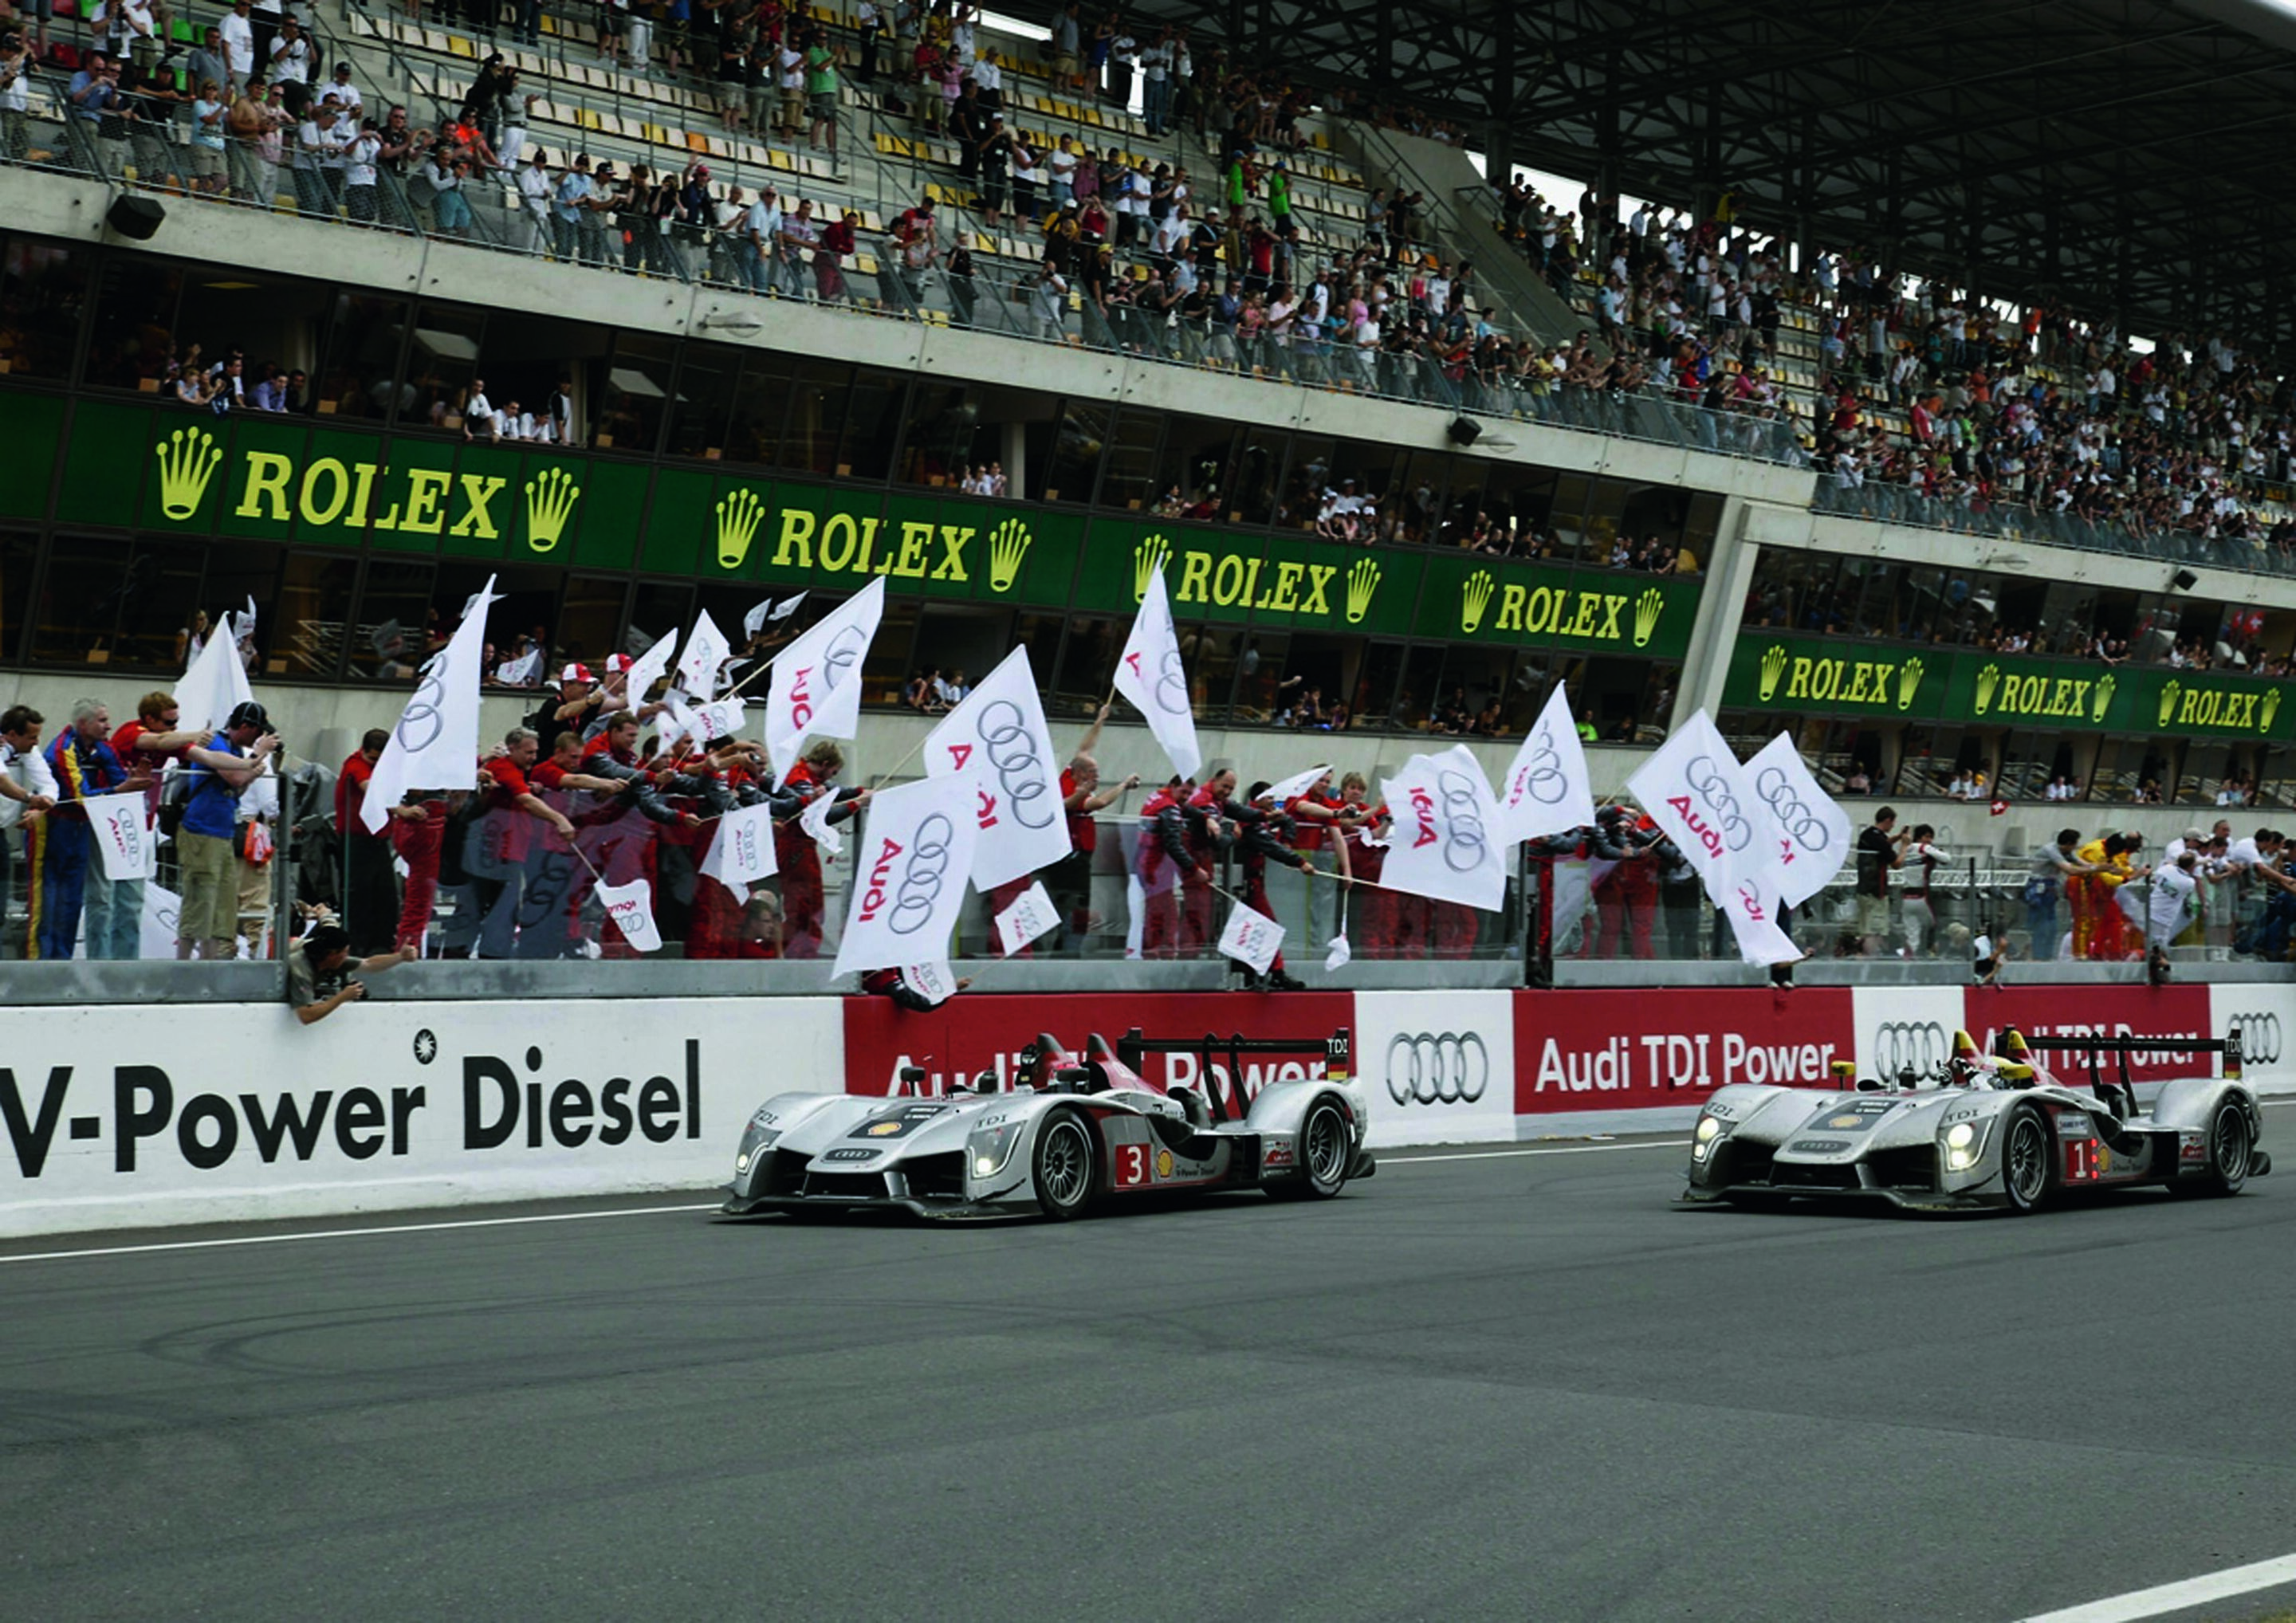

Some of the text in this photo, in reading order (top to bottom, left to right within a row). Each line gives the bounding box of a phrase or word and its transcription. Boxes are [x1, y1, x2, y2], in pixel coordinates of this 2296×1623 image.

[235, 451, 506, 539] ROLEX
[771, 509, 976, 581] ROLEX
[1176, 551, 1337, 614] ROLEX
[1496, 584, 1628, 639] ROLEX
[1787, 658, 1894, 703] ROLEX
[1998, 675, 2090, 717] ROLEX
[2178, 690, 2259, 727] ROLEX
[1666, 796, 1724, 859] Audi
[859, 838, 903, 922] Audi
[1327, 1038, 1348, 1054] TDI
[1535, 1032, 1835, 1092] Audi TDI Power
[0, 1039, 700, 1178] V-Power Diesel
[977, 1114, 1008, 1127] TDI
[1706, 1101, 1734, 1117] TDI
[1948, 1110, 1979, 1122] TDI
[1126, 1146, 1143, 1185] 3
[2074, 1142, 2087, 1178] 1
